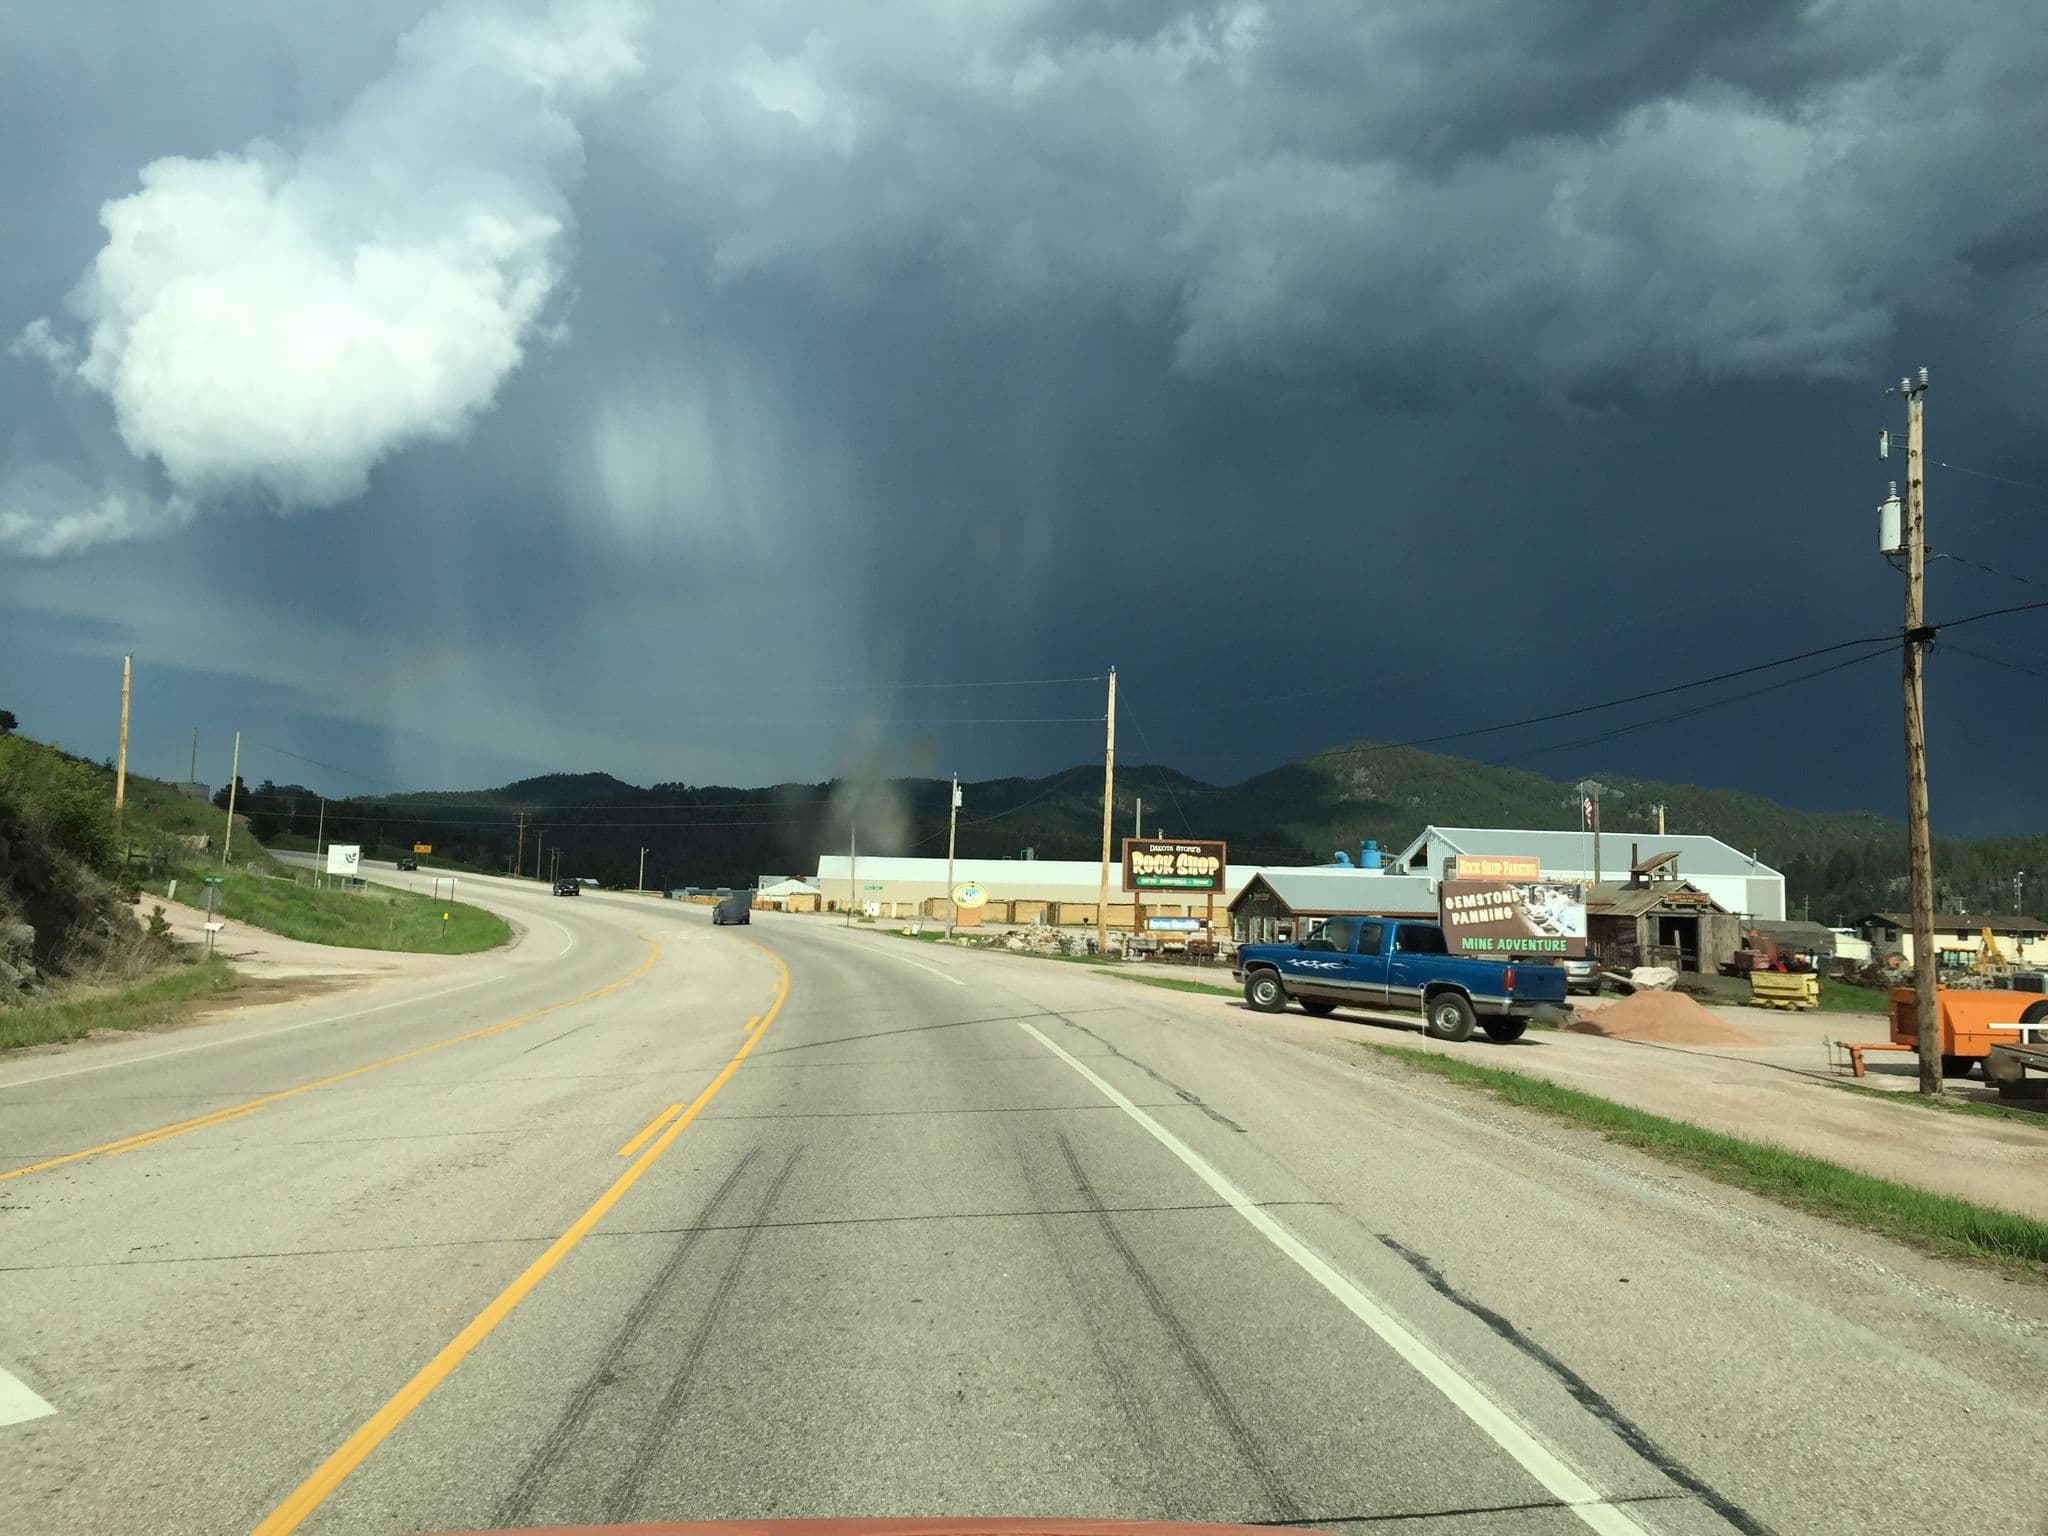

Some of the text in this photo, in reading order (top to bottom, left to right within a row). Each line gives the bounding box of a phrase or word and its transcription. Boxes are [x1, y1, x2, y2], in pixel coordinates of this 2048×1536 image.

[1131, 851, 1220, 876] ROCK SHOP
[1459, 859, 1481, 875] ROCK
[1482, 860, 1501, 875] SHOP
[1445, 890, 1521, 910] GEMSTONE
[1452, 906, 1514, 926] PANNING
[1461, 937, 1567, 952] MINE ADVENTURE
